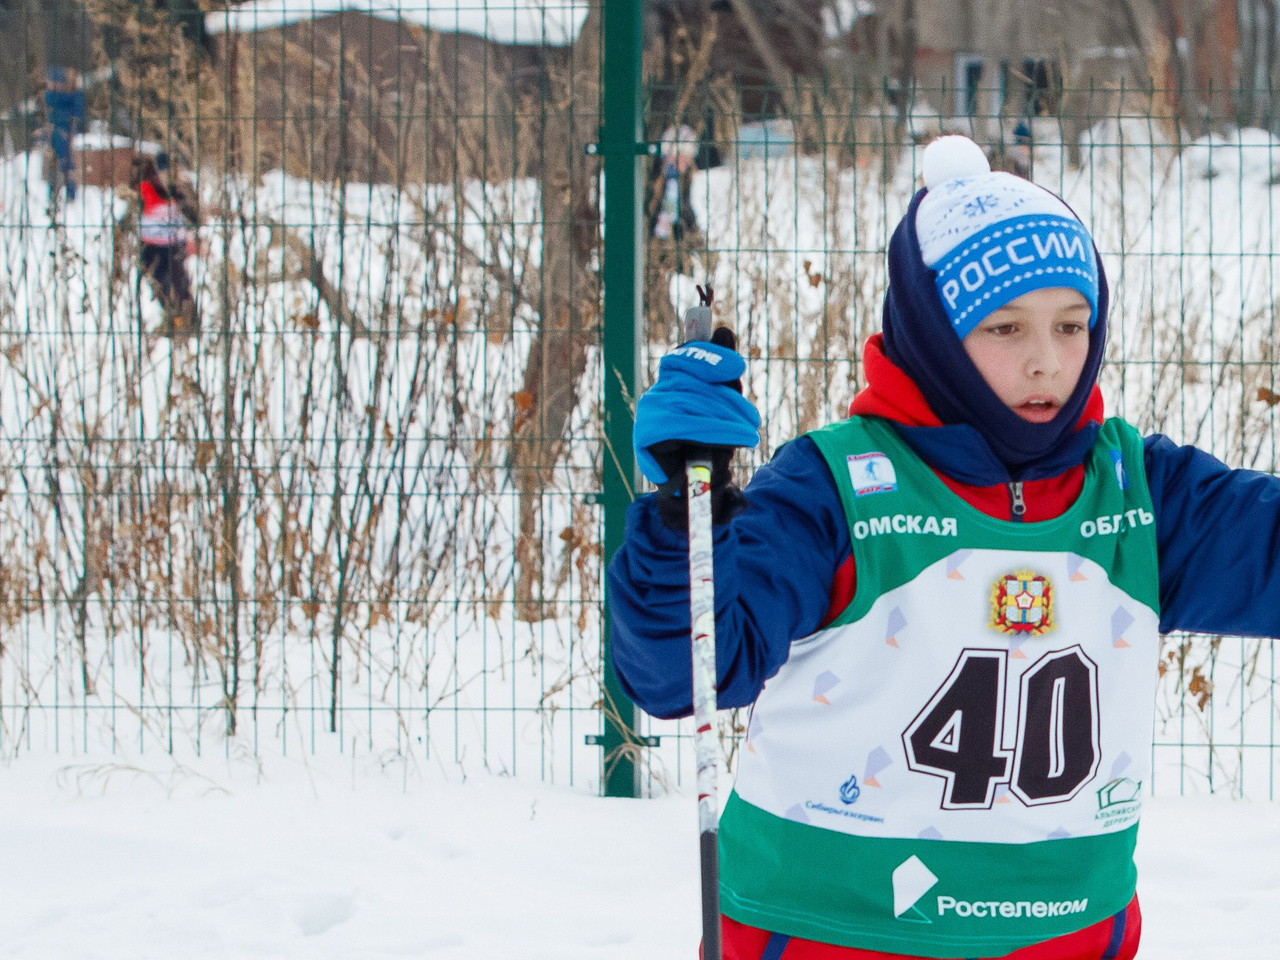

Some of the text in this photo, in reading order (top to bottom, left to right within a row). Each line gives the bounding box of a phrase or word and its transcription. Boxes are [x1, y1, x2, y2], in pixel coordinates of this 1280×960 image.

[942, 232, 1086, 310] РОССИИ
[853, 507, 1154, 540] ОМСКАЯ ОБЛТЬ
[901, 643, 1102, 810] 40
[936, 895, 1089, 918] Ростелеком
